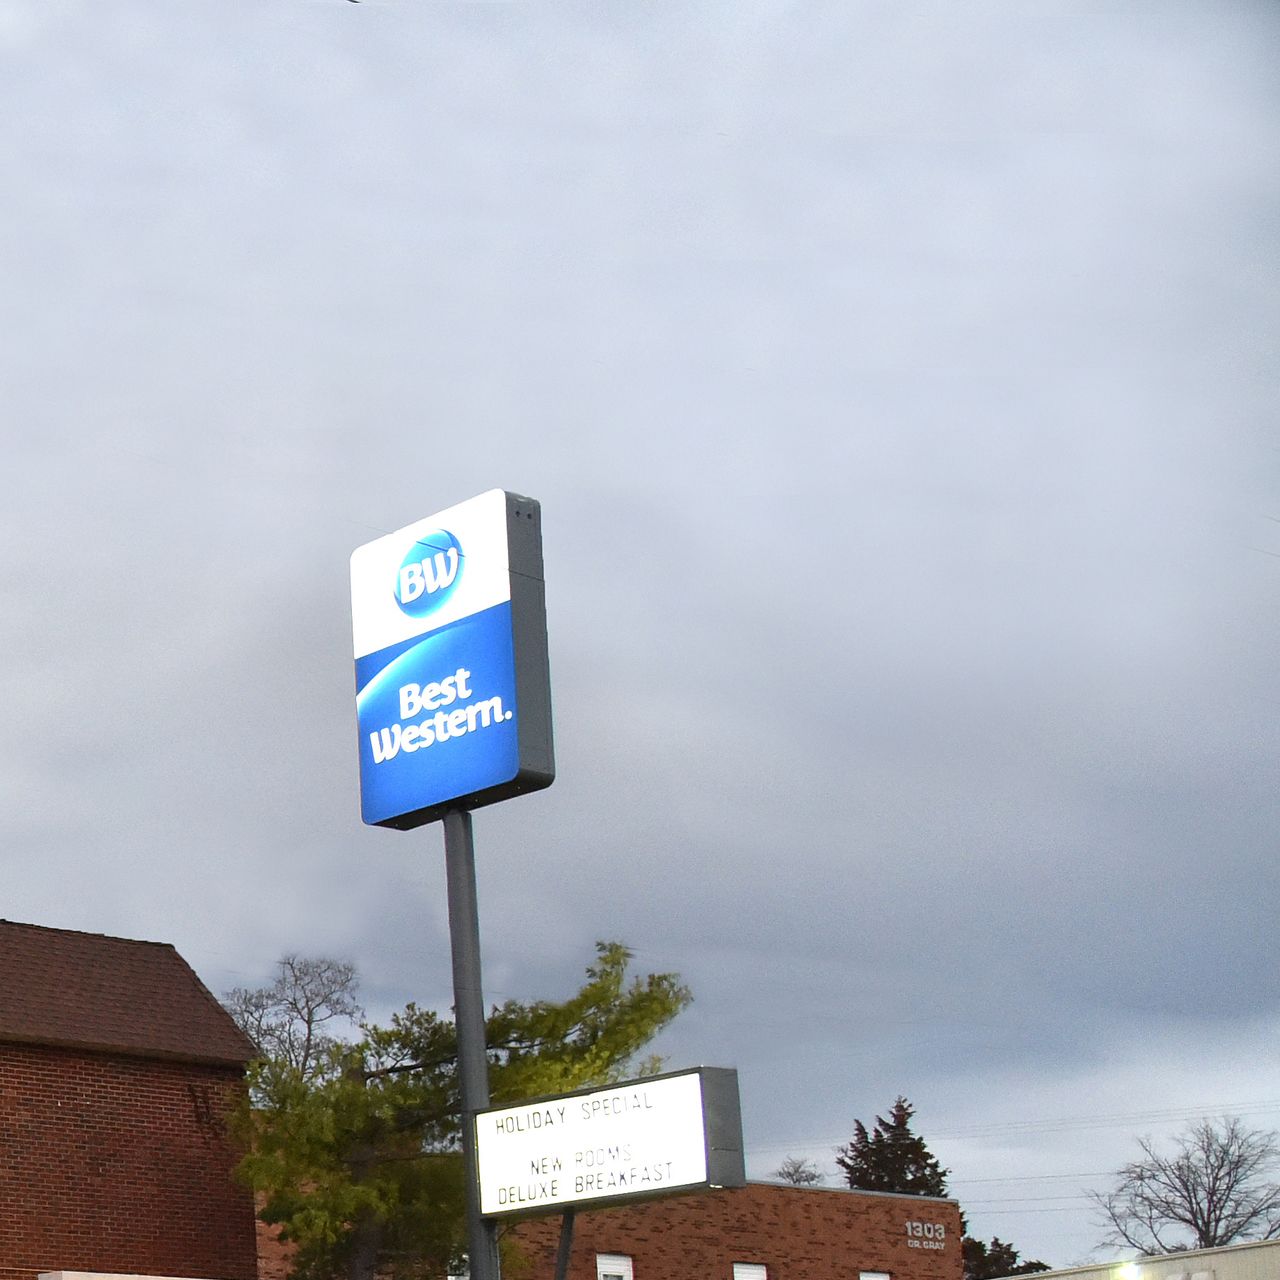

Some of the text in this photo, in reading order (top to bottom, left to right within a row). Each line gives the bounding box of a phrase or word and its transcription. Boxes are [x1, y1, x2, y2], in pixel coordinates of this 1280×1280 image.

[399, 547, 458, 604] BW
[399, 667, 472, 720] Best
[495, 1093, 653, 1135] HOLIDAY SPECIAL
[531, 1144, 633, 1175] NEW ROOMS
[498, 1162, 673, 1205] DELUXE BREAKFAST
[905, 1221, 945, 1240] 1303
[923, 1241, 946, 1250] GRAY
